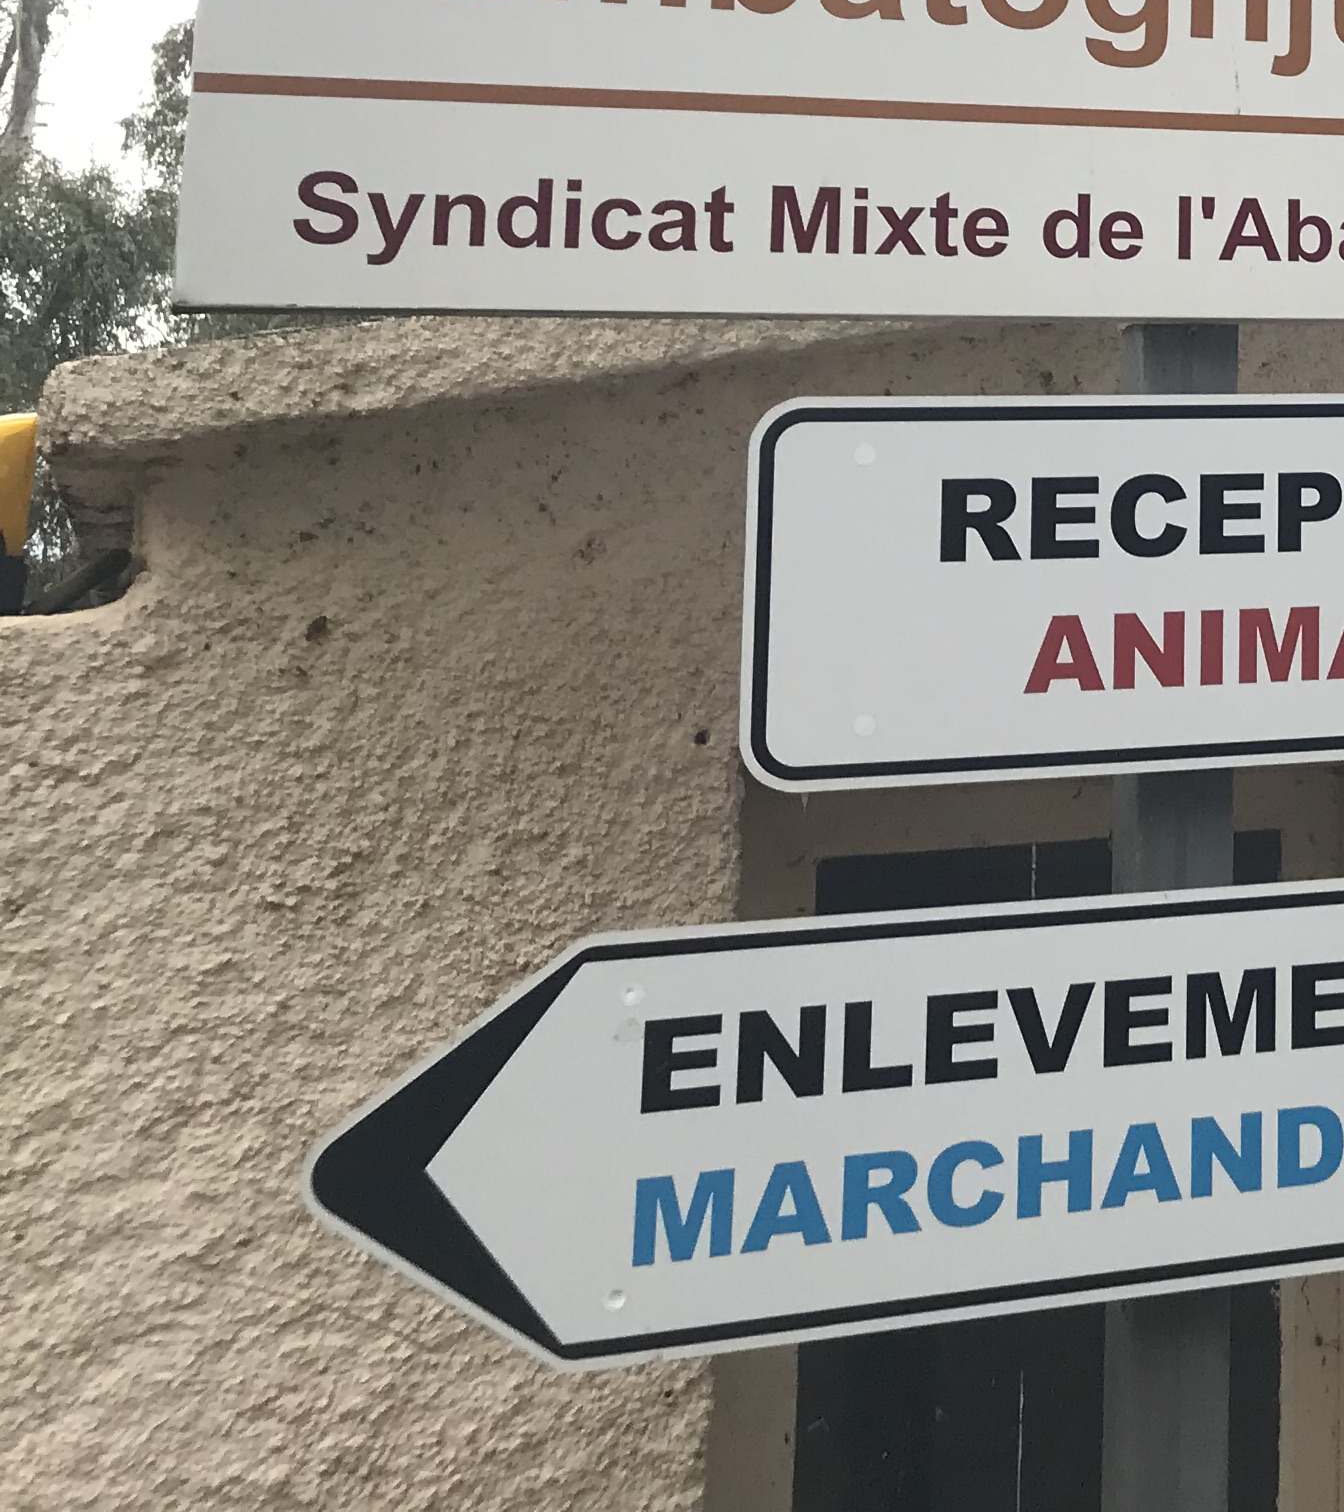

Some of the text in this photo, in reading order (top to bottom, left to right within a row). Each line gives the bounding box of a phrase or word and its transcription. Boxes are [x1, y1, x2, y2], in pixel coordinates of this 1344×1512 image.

[292, 170, 735, 266] Syndicat
[769, 184, 1010, 258] Mixte
[1042, 192, 1144, 260] de
